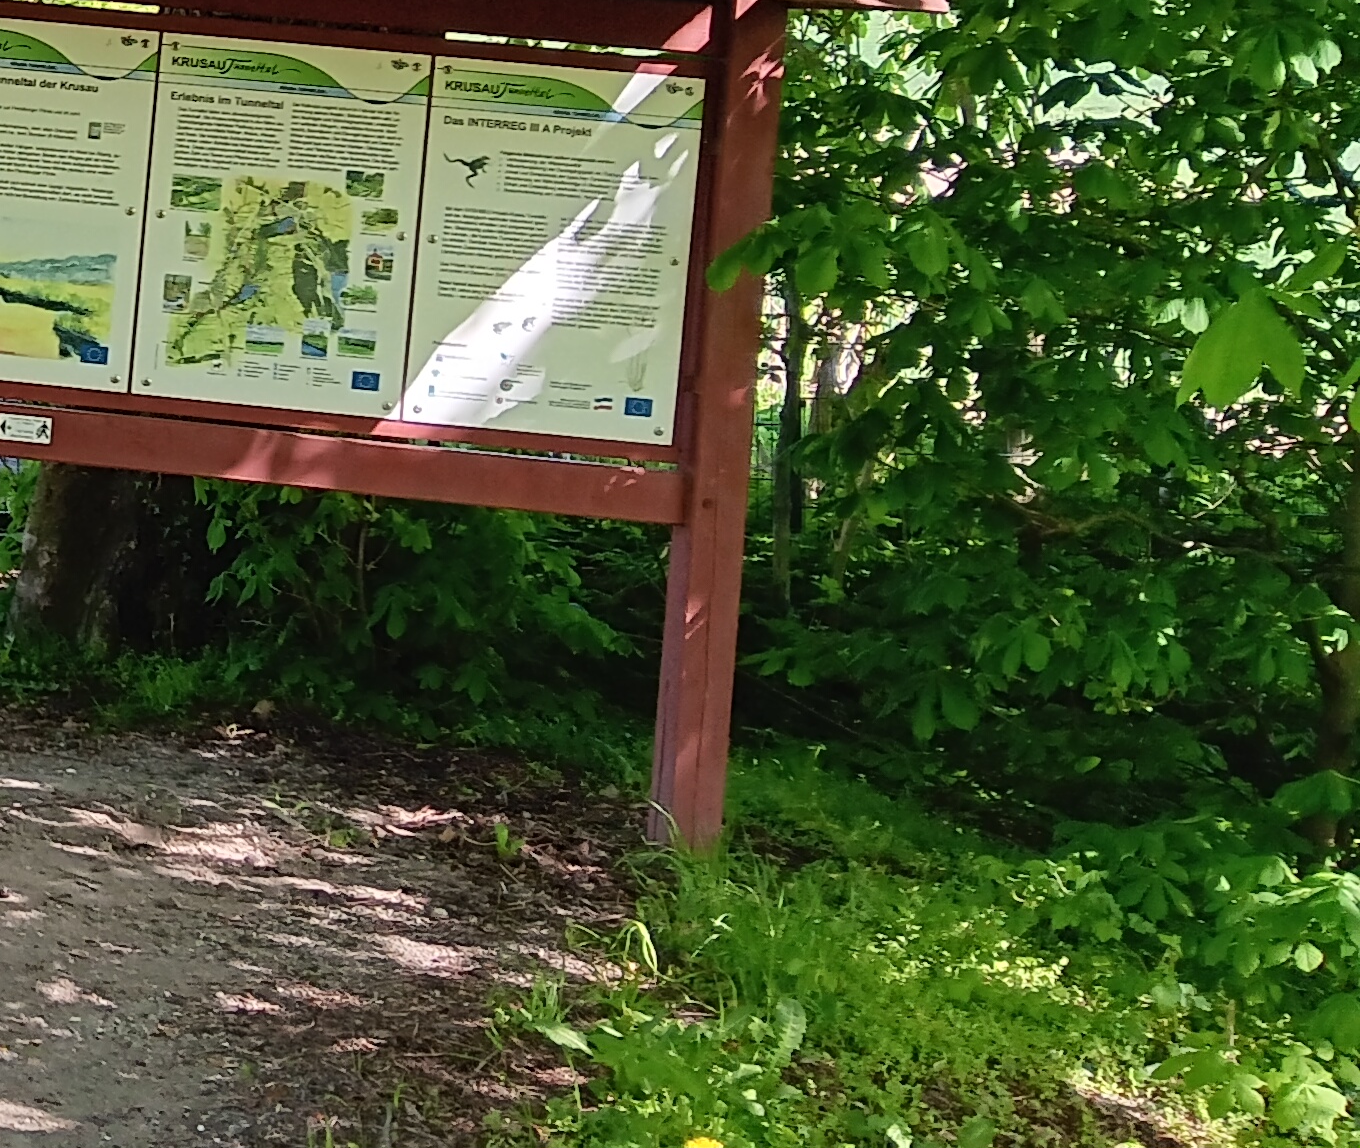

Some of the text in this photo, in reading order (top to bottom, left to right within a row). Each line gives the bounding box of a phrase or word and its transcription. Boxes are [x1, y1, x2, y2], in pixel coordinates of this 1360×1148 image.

[171, 56, 225, 71] KRUSAU
[39, 78, 57, 90] der
[60, 81, 99, 94] Krusau
[444, 80, 500, 95] KRUSAU
[170, 91, 284, 110] Erlebnis im Tunneltal
[443, 115, 592, 138] Das INTERREG III A Projekt
